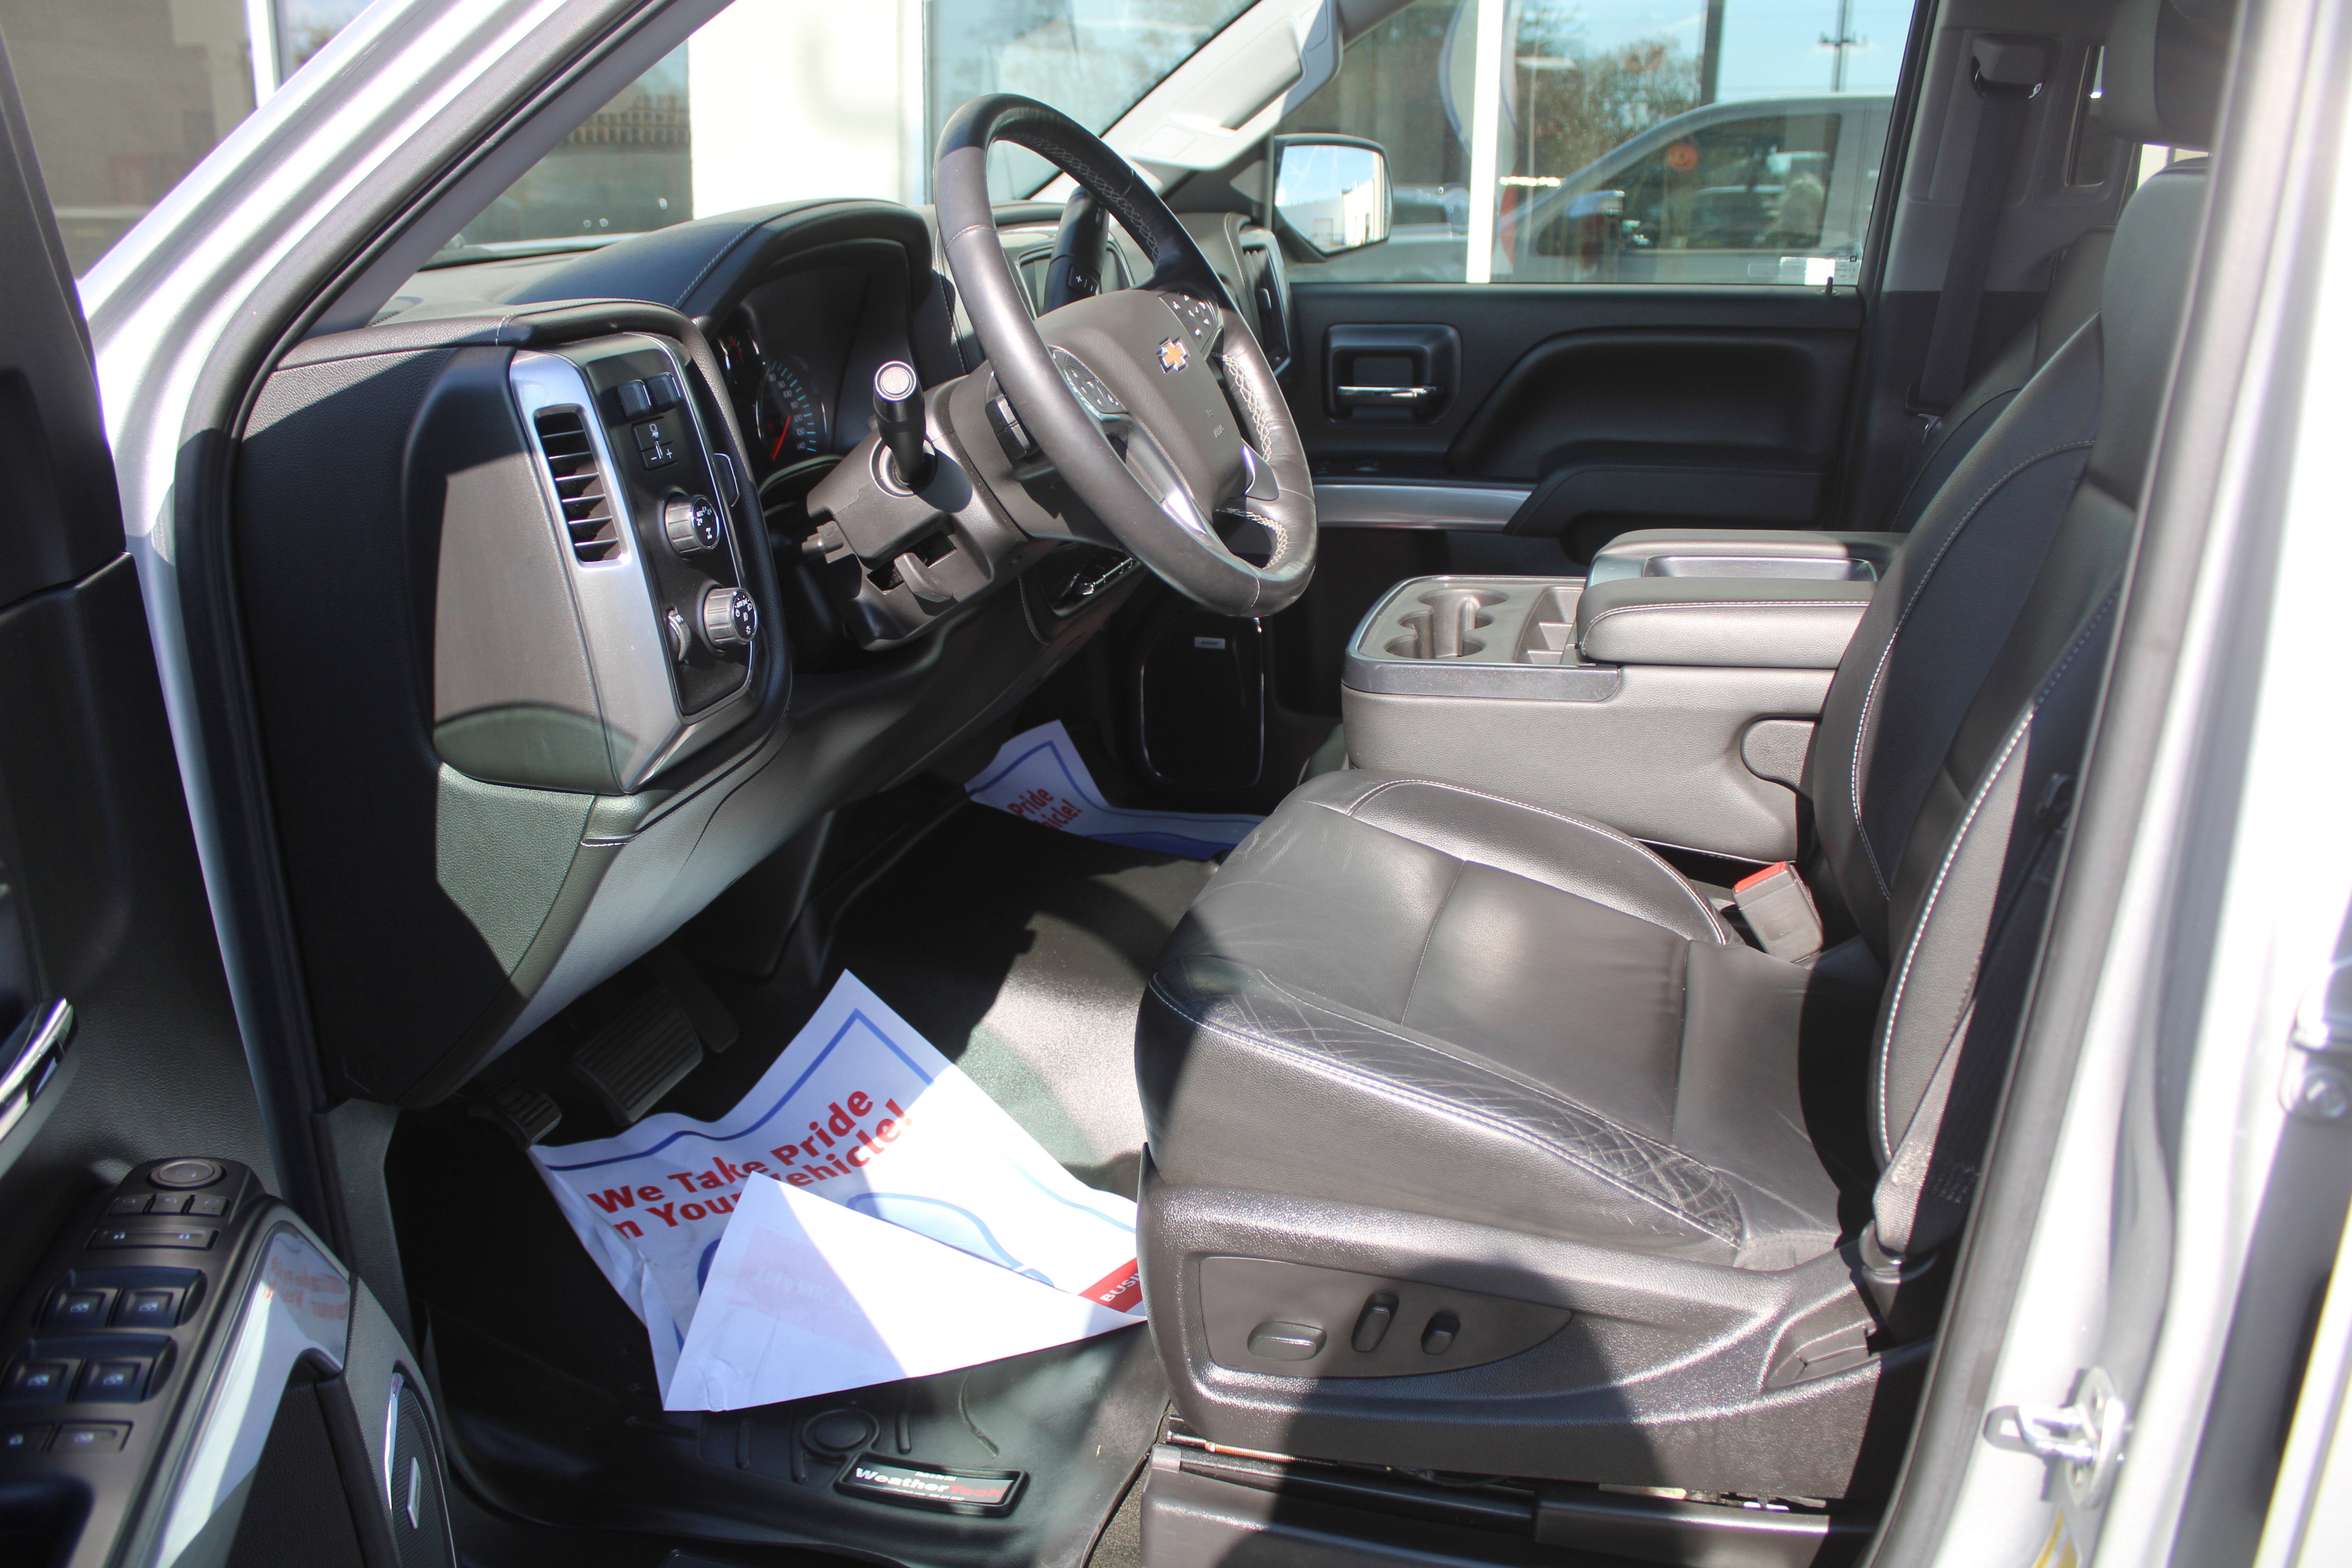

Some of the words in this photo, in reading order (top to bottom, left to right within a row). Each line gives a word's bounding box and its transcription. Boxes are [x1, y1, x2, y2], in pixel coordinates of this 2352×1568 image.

[783, 390, 792, 398] 100
[1007, 788, 1054, 818] Pride
[586, 1185, 665, 1214] We
[667, 1156, 770, 1193] Take
[770, 1091, 873, 1166] Pride
[613, 1220, 644, 1240] n
[770, 1098, 912, 1187] ehicle!
